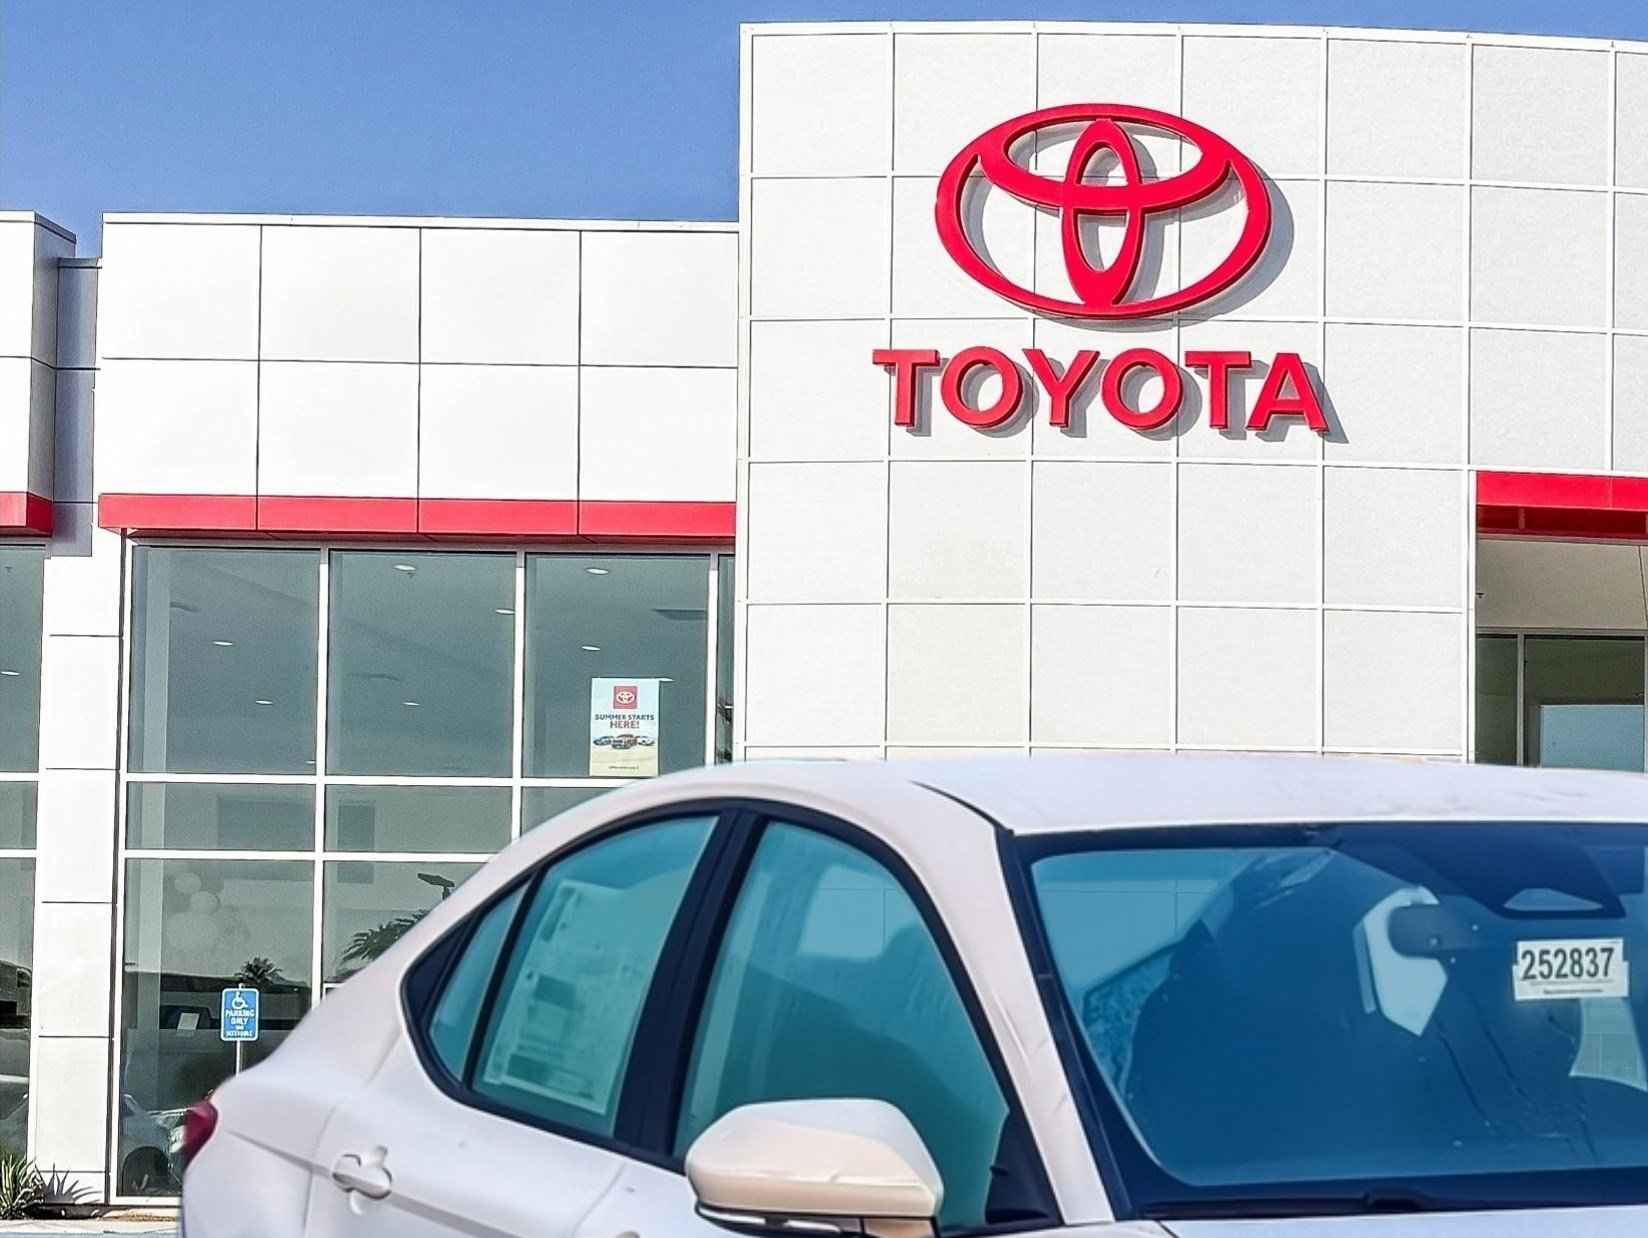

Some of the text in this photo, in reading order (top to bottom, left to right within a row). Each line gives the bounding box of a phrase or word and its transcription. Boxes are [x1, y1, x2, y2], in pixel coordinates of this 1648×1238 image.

[872, 346, 1330, 435] TOYOTA
[609, 721, 640, 729] HERE!
[1520, 947, 1615, 981] 252837
